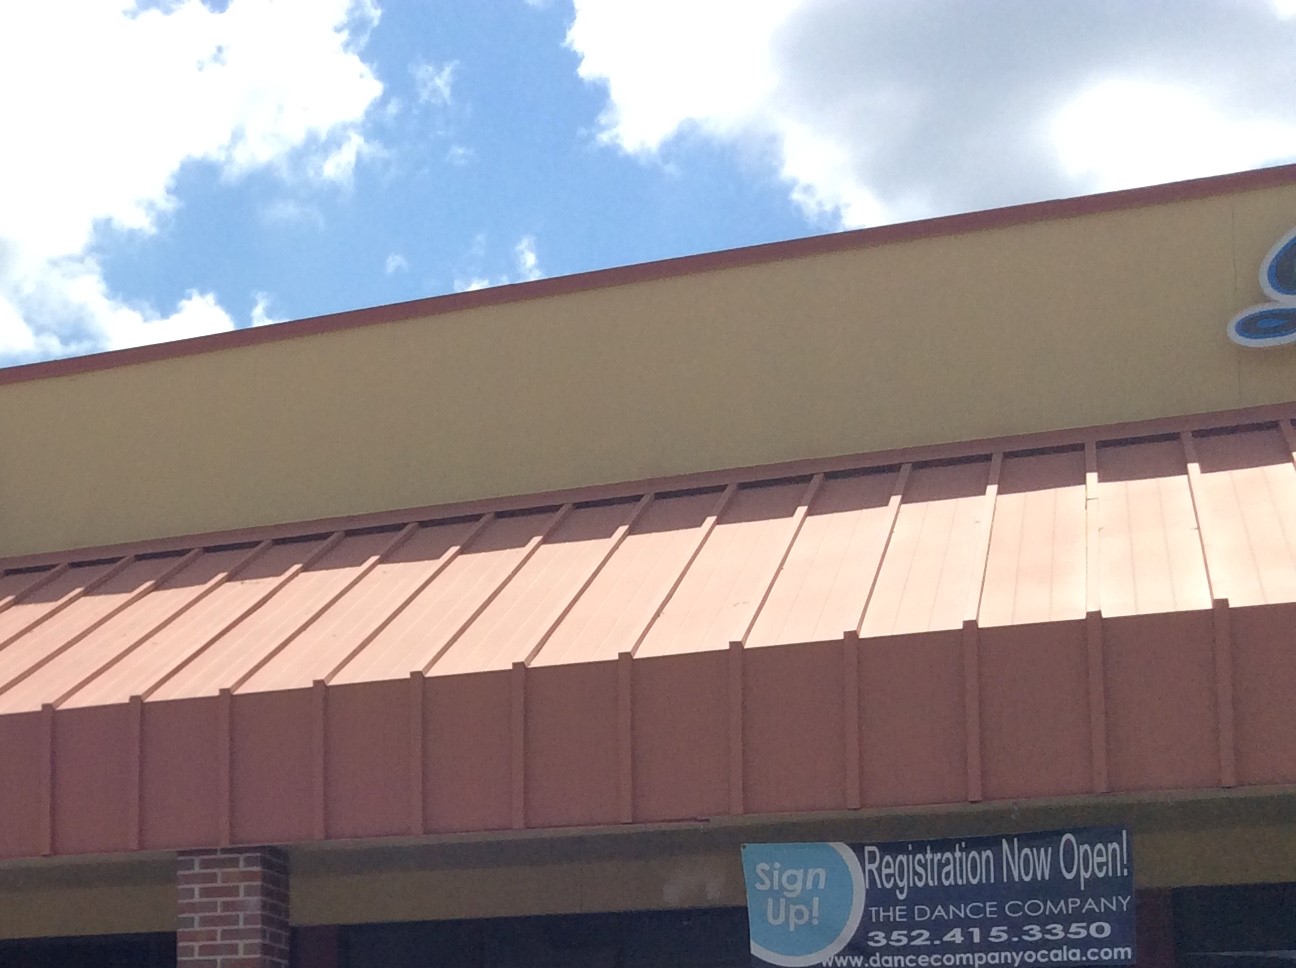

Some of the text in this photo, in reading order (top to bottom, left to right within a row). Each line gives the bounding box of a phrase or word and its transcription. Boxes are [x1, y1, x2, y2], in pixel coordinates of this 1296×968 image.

[863, 829, 1129, 899] Registration Now Open!
[754, 862, 826, 898] Sign
[767, 896, 820, 931] Up!
[868, 895, 1132, 923] THE DANCE COMPANY
[866, 921, 1112, 948] 352.415.3350
[821, 944, 1133, 968] www.dancecompanyocala.com
